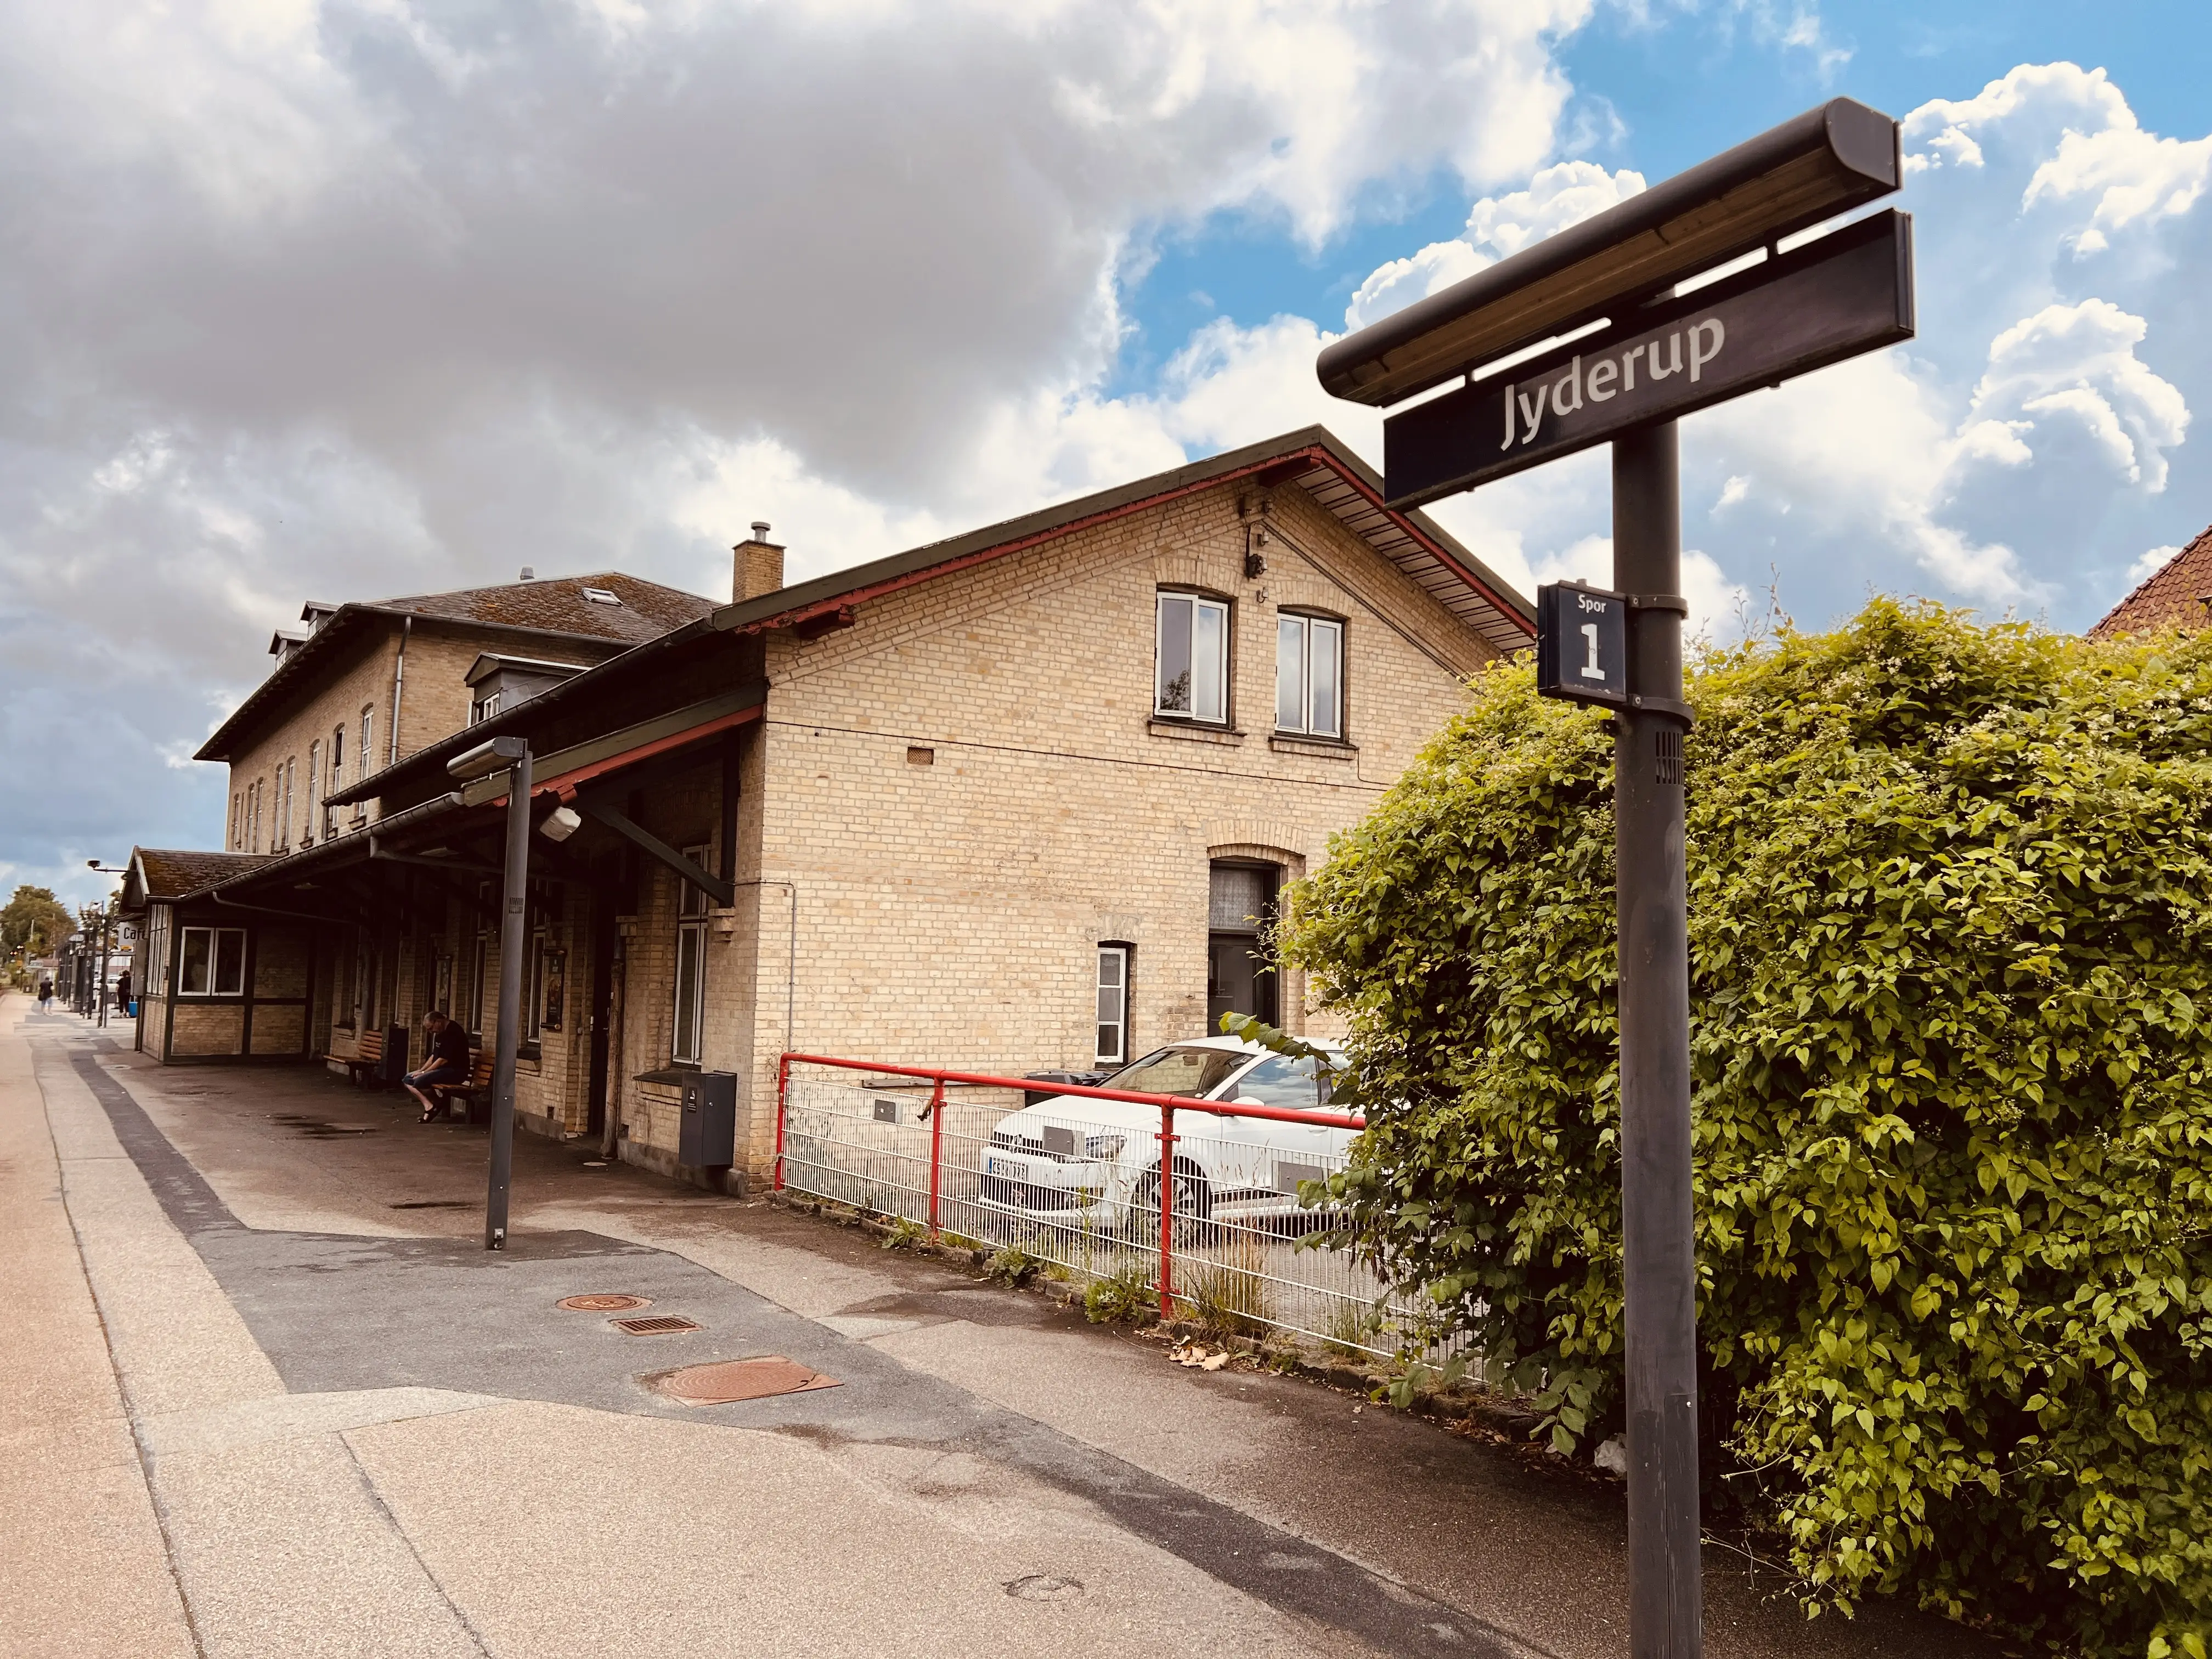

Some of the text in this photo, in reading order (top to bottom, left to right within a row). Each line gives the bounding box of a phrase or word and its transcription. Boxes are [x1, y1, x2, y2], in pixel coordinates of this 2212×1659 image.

[1500, 318, 1724, 451] Jyderup
[1578, 594, 1606, 613] Spor
[1581, 623, 1605, 680] 1
